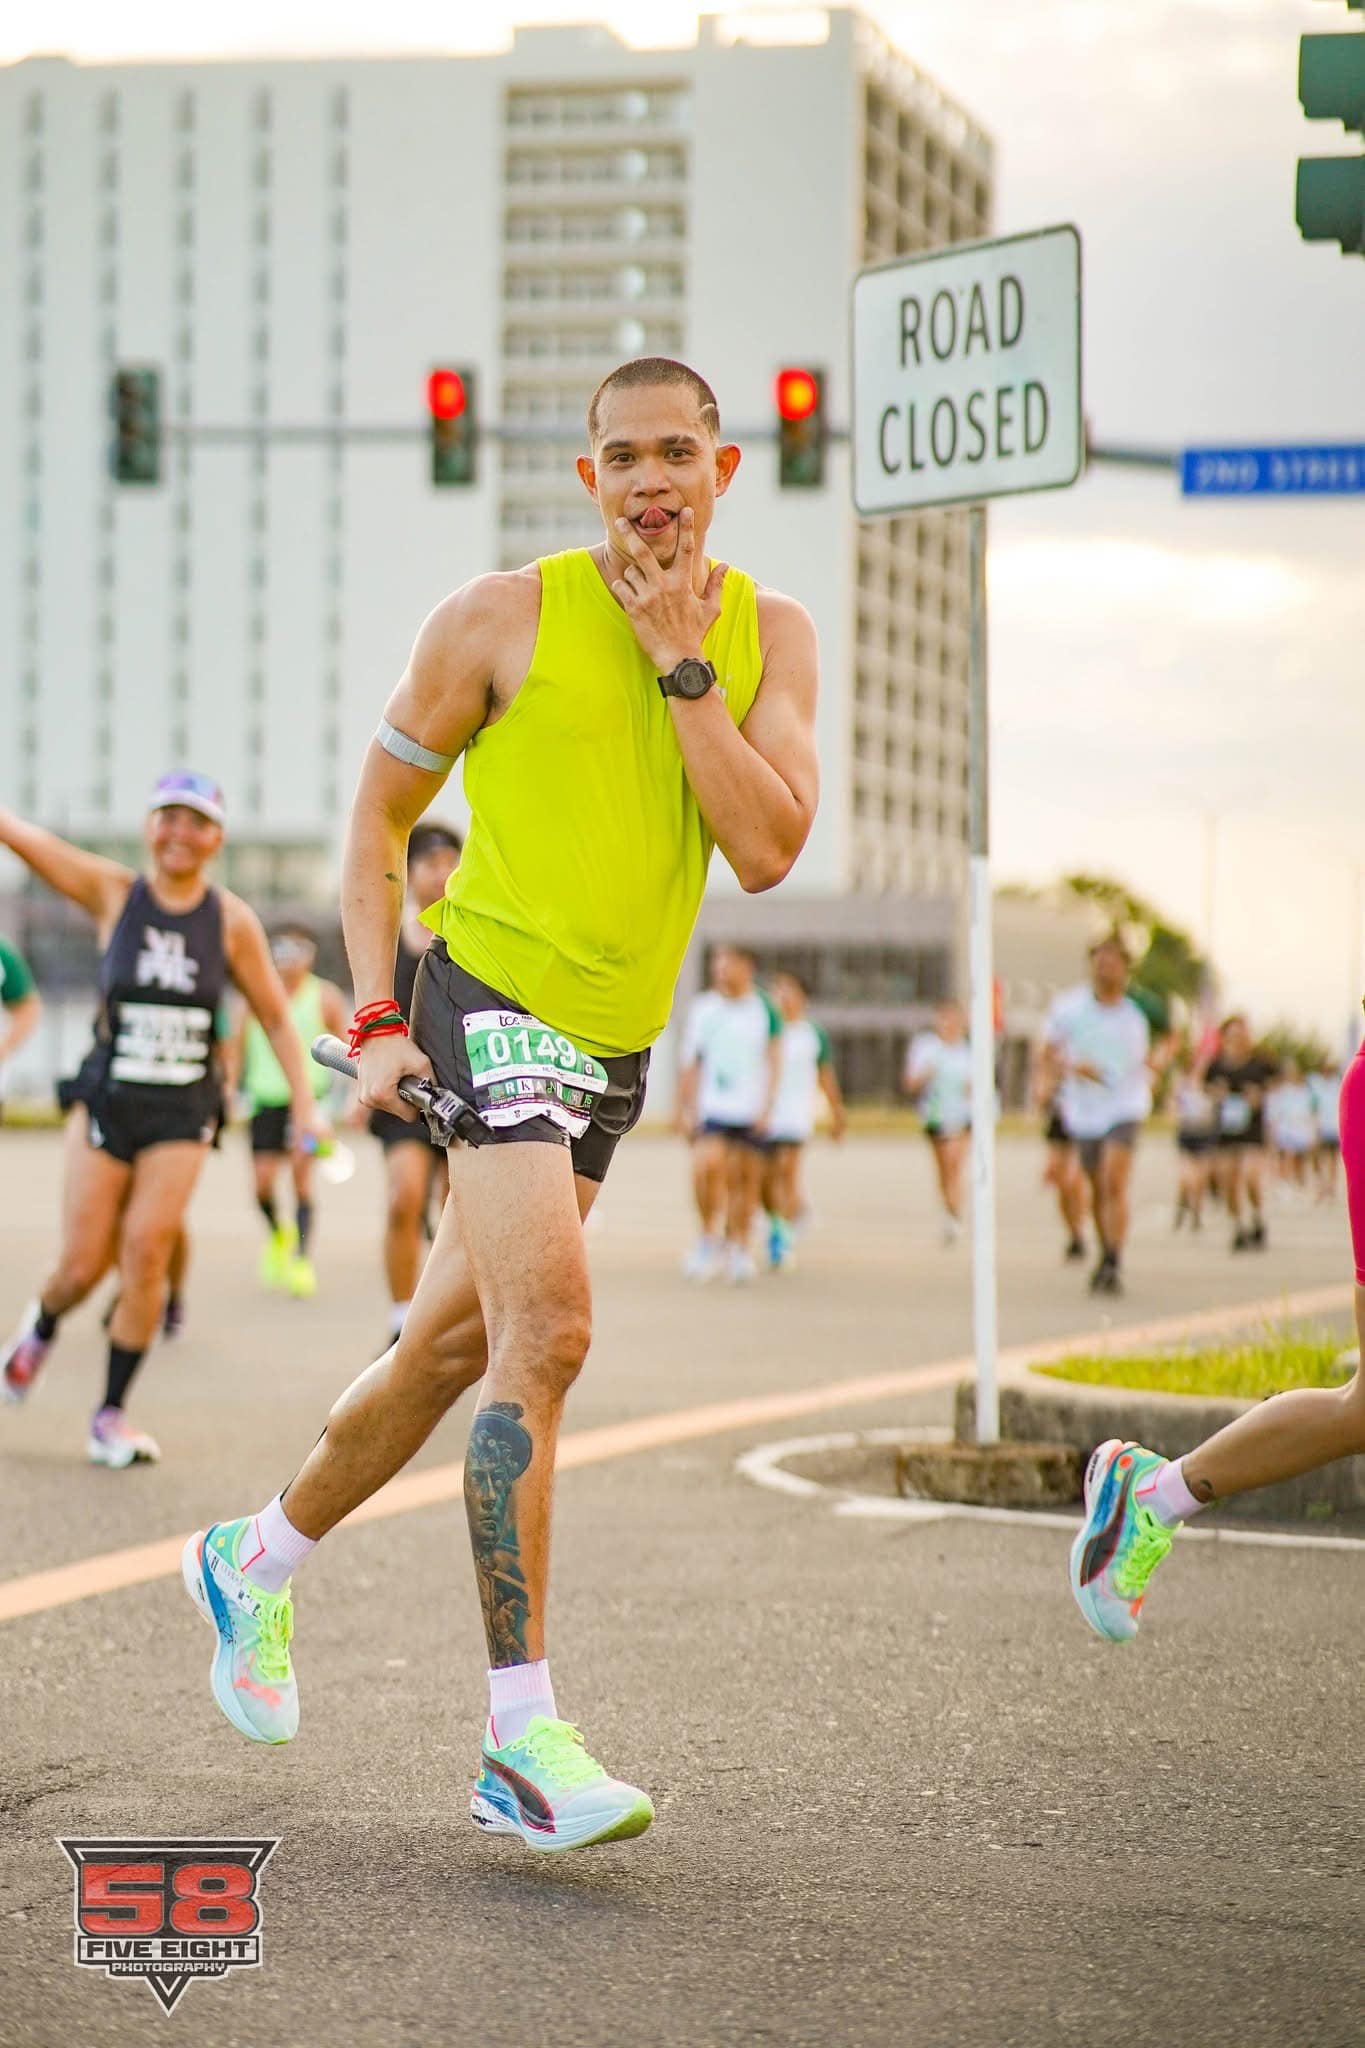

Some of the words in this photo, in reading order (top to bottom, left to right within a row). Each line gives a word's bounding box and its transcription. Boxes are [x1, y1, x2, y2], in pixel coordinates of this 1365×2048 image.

[899, 275, 1024, 369] ROAD
[878, 380, 1049, 475] CLOSED
[487, 1029, 577, 1069] 0149
